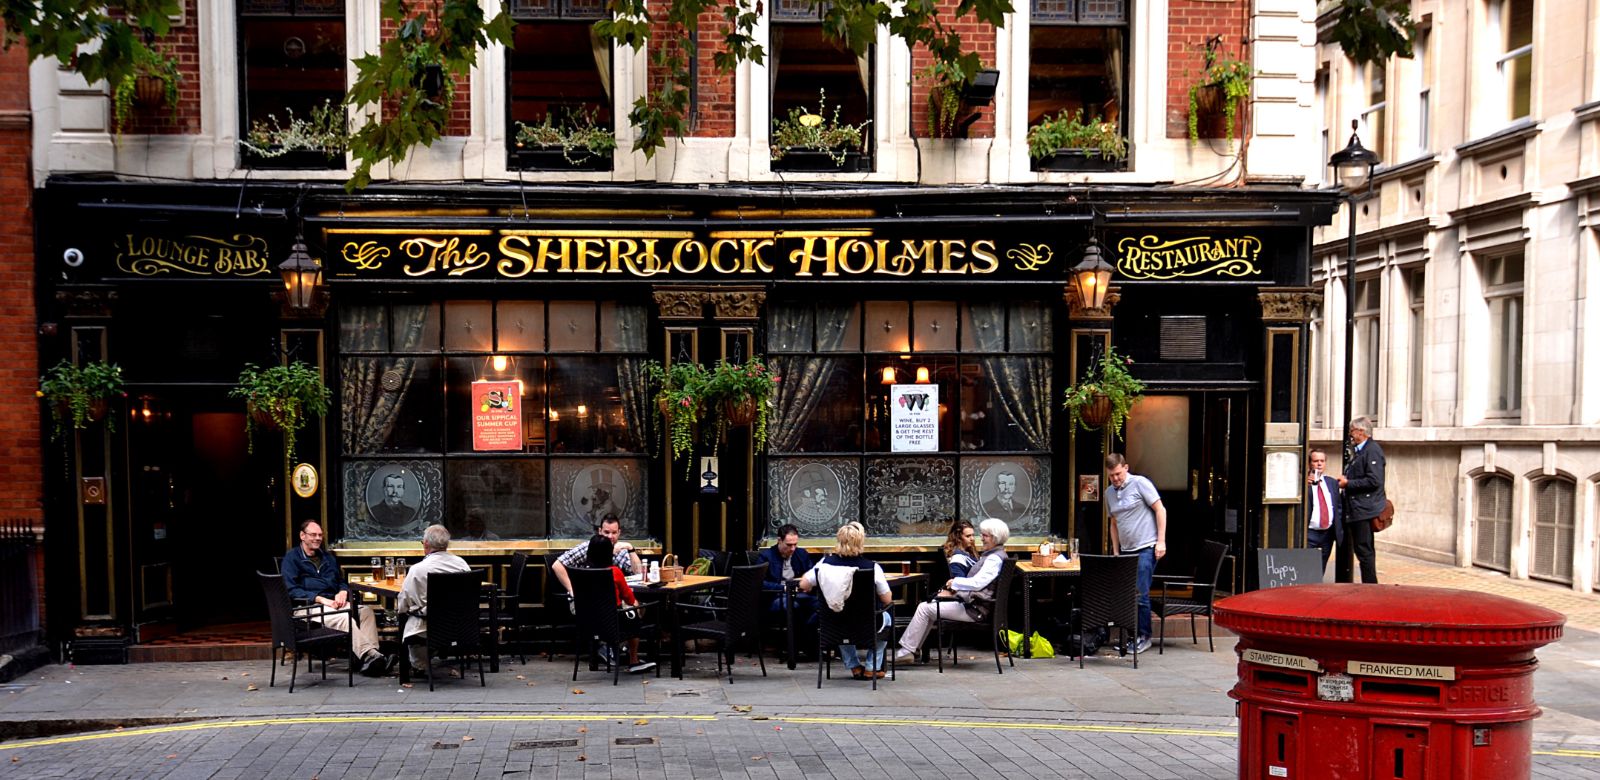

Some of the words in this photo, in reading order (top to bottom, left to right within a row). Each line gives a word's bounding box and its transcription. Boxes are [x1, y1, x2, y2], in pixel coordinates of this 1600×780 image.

[126, 234, 210, 268] LOUNGE
[215, 247, 262, 274] BAR
[399, 236, 491, 277] The
[497, 234, 774, 278] SHERLOCK
[789, 236, 1000, 277] HOLMES
[1124, 238, 1253, 274] RESTAURANT
[902, 394, 929, 411] W
[1265, 554, 1297, 581] Happy
[1249, 651, 1284, 665] STAMPED
[1285, 656, 1306, 668] MAIL
[1359, 663, 1413, 676] FRANKED
[1414, 667, 1443, 678] MAIL
[1447, 685, 1510, 703] OFFICE
